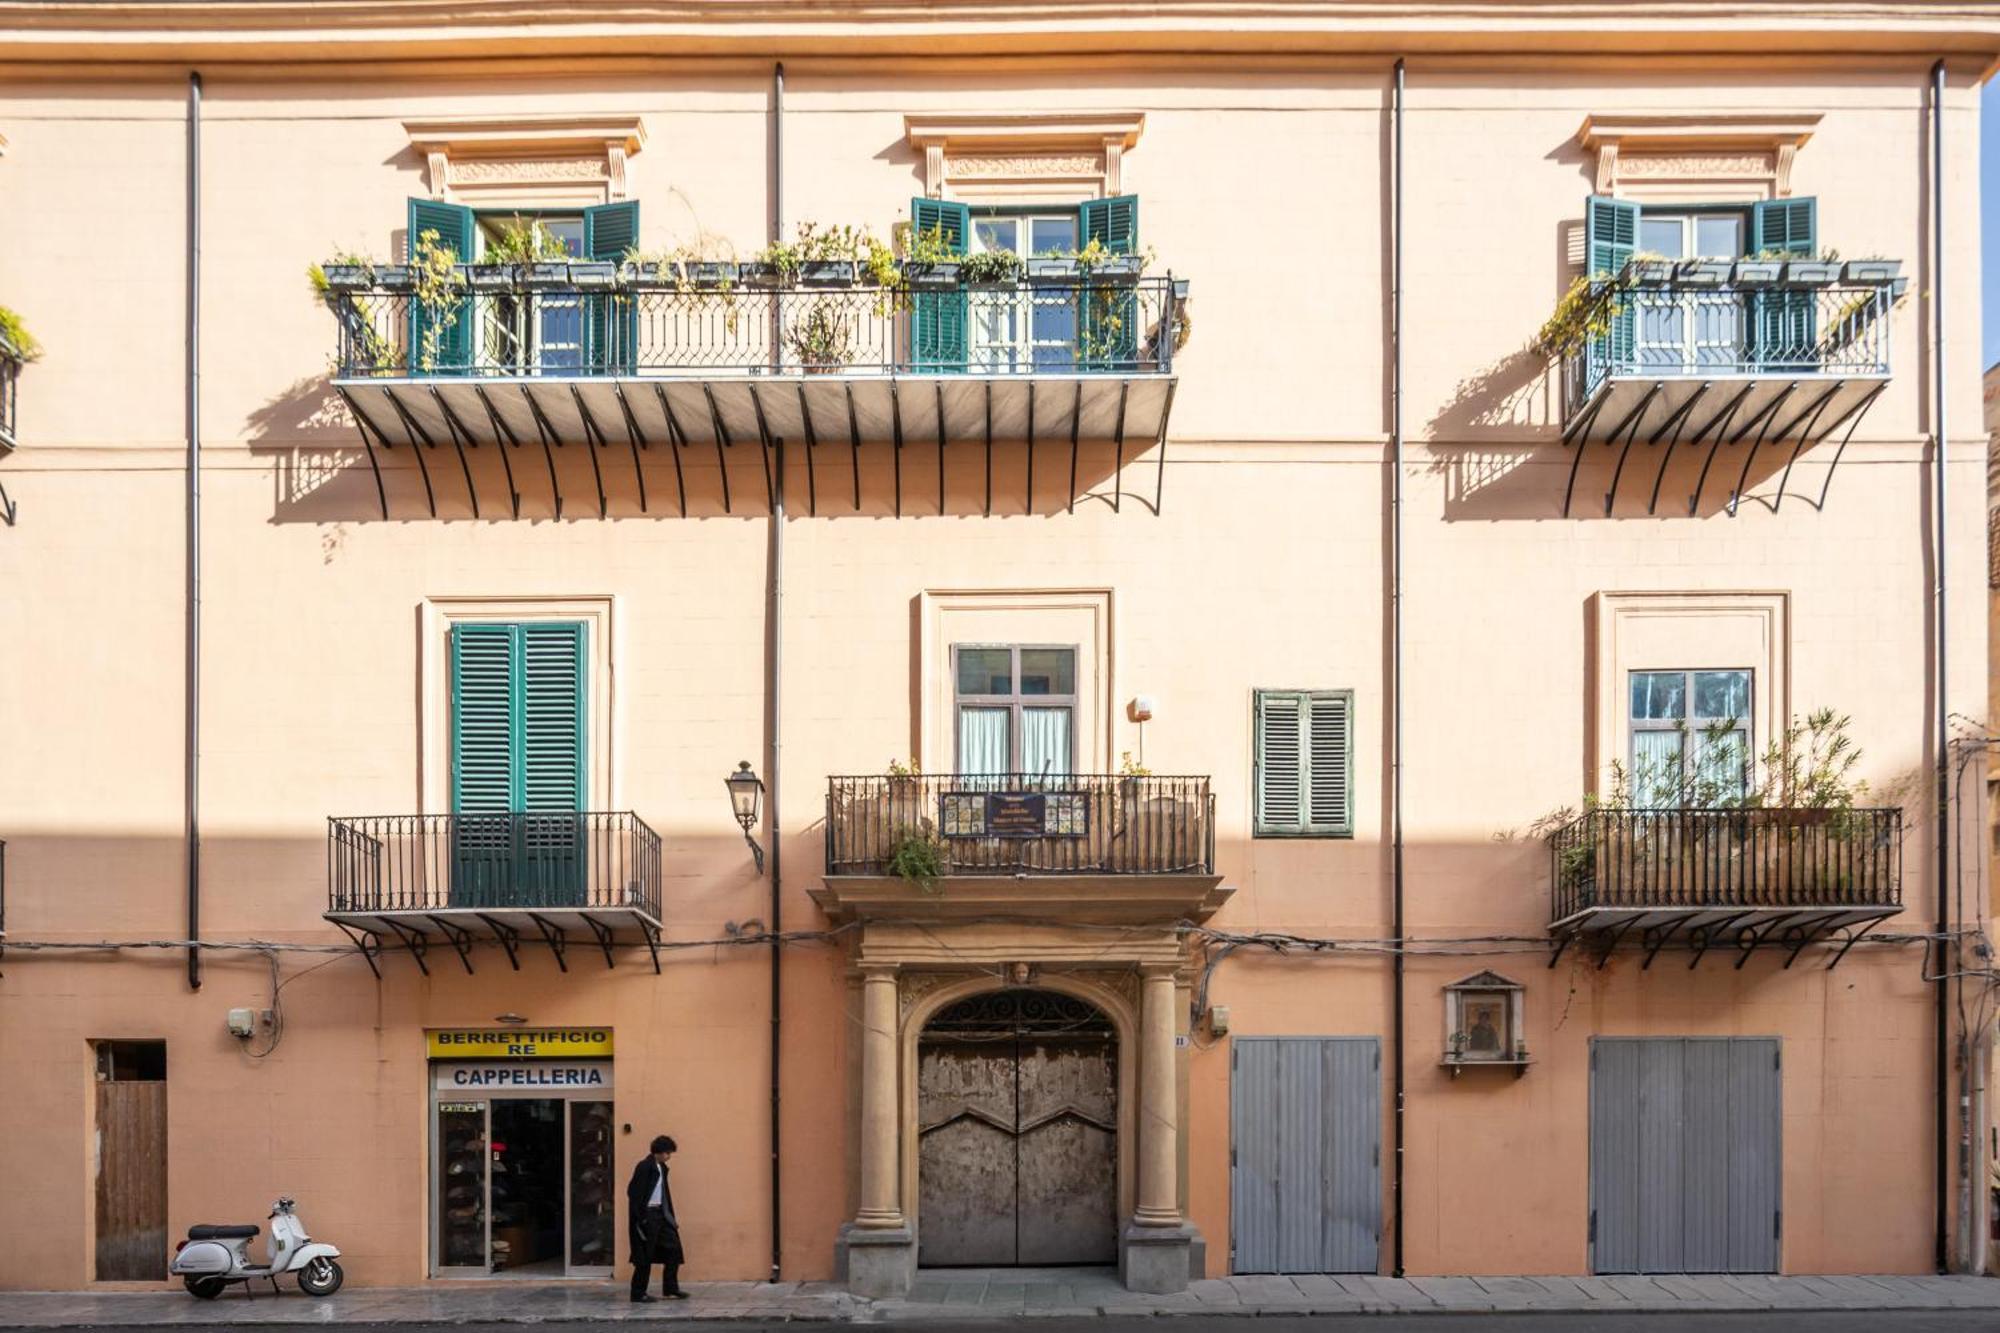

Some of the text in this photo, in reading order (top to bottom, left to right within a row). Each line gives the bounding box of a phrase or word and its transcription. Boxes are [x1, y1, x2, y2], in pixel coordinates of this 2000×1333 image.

[438, 1032, 606, 1044] BERRETTIFICIO
[508, 1045, 536, 1055] RE
[454, 1069, 602, 1085] CAPPELLERIA
